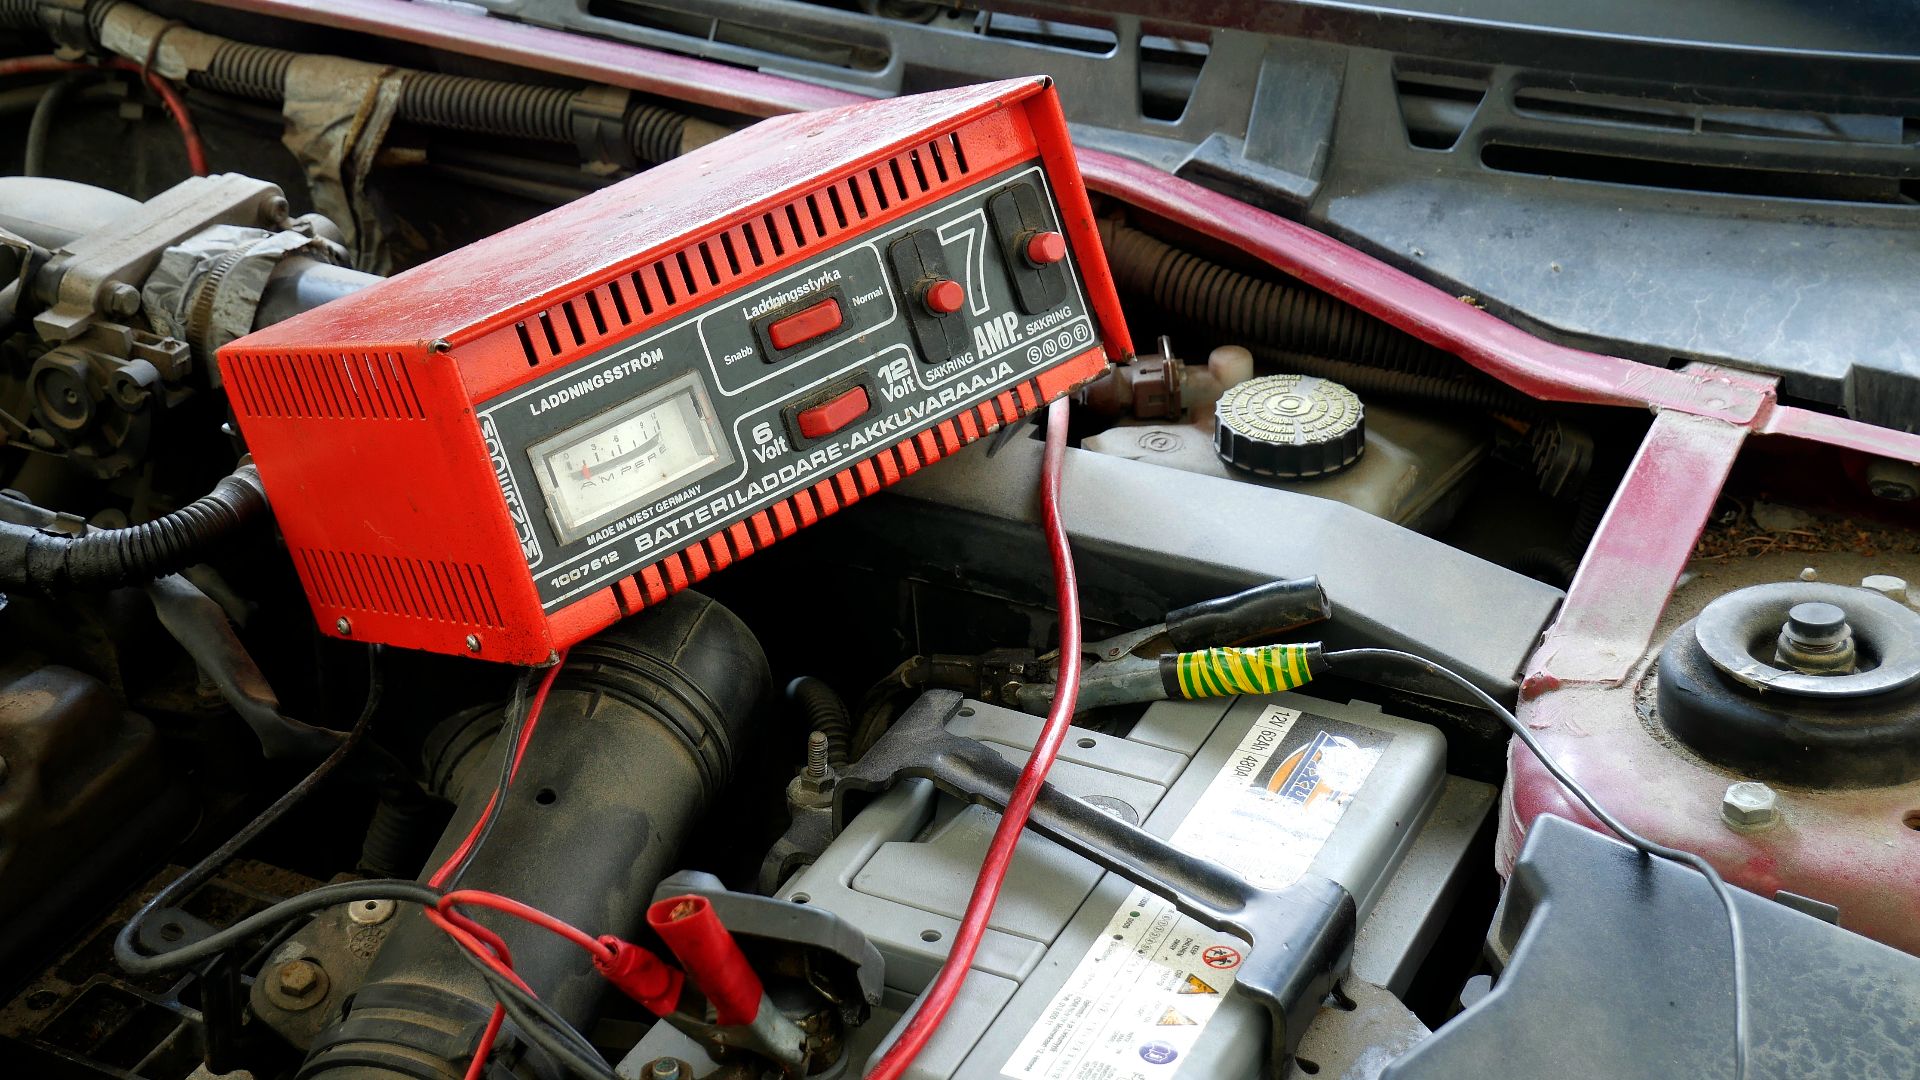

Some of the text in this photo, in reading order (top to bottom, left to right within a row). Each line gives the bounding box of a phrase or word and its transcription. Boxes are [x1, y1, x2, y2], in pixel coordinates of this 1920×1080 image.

[936, 207, 990, 317] 7
[743, 269, 842, 320] Laddningsstyrka
[852, 286, 884, 307] Normal
[973, 311, 1023, 360] AMP.
[1026, 306, 1073, 336] SÄKRING
[724, 345, 753, 366] Snabb
[877, 357, 911, 384] 12
[926, 352, 974, 382] SÄKRING
[529, 348, 665, 416] LADDNINGSSTRÖM
[881, 379, 917, 403] Volt
[752, 421, 774, 444] 6
[752, 436, 788, 464] Volt
[580, 443, 667, 490] AMPERE
[586, 485, 702, 546] MADE IN WEST GERMANY
[550, 550, 620, 588] 1007612
[1268, 711, 1291, 728] 12V
[1250, 730, 1277, 752] 62Ah
